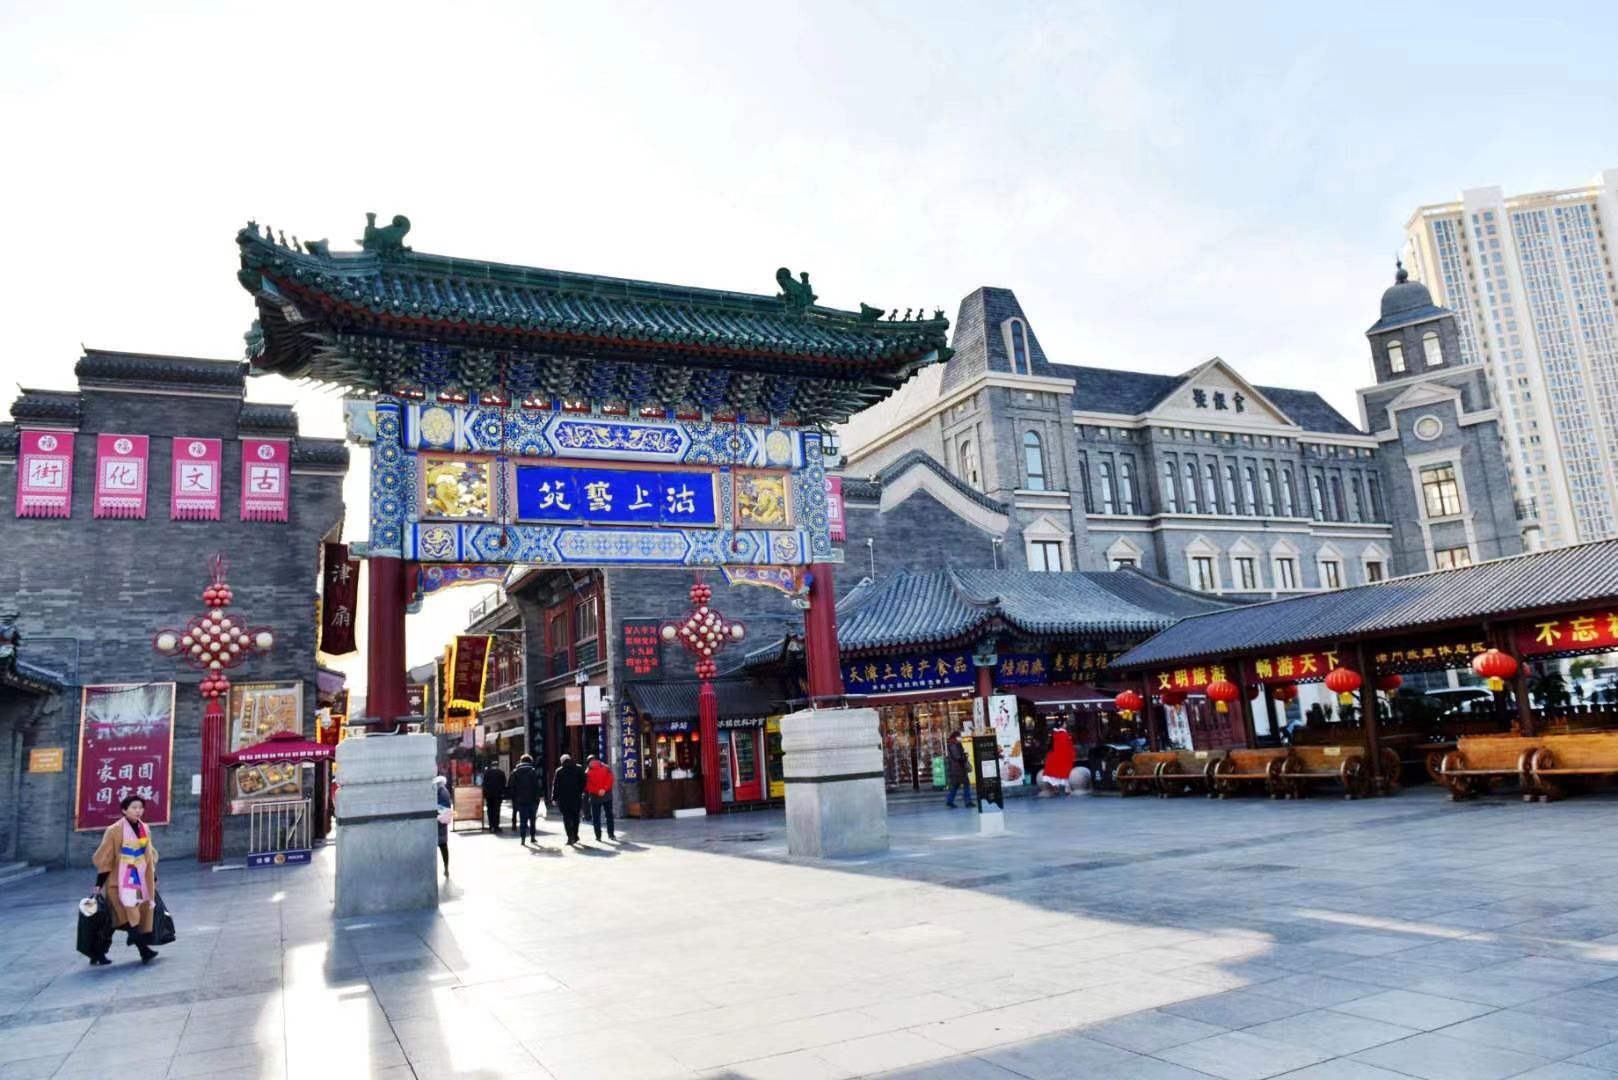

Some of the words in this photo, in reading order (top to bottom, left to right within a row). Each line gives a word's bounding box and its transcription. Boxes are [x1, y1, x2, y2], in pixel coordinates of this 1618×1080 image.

[1157, 665, 1227, 690] 文明旅游
[1255, 650, 1340, 679] 畅游天下
